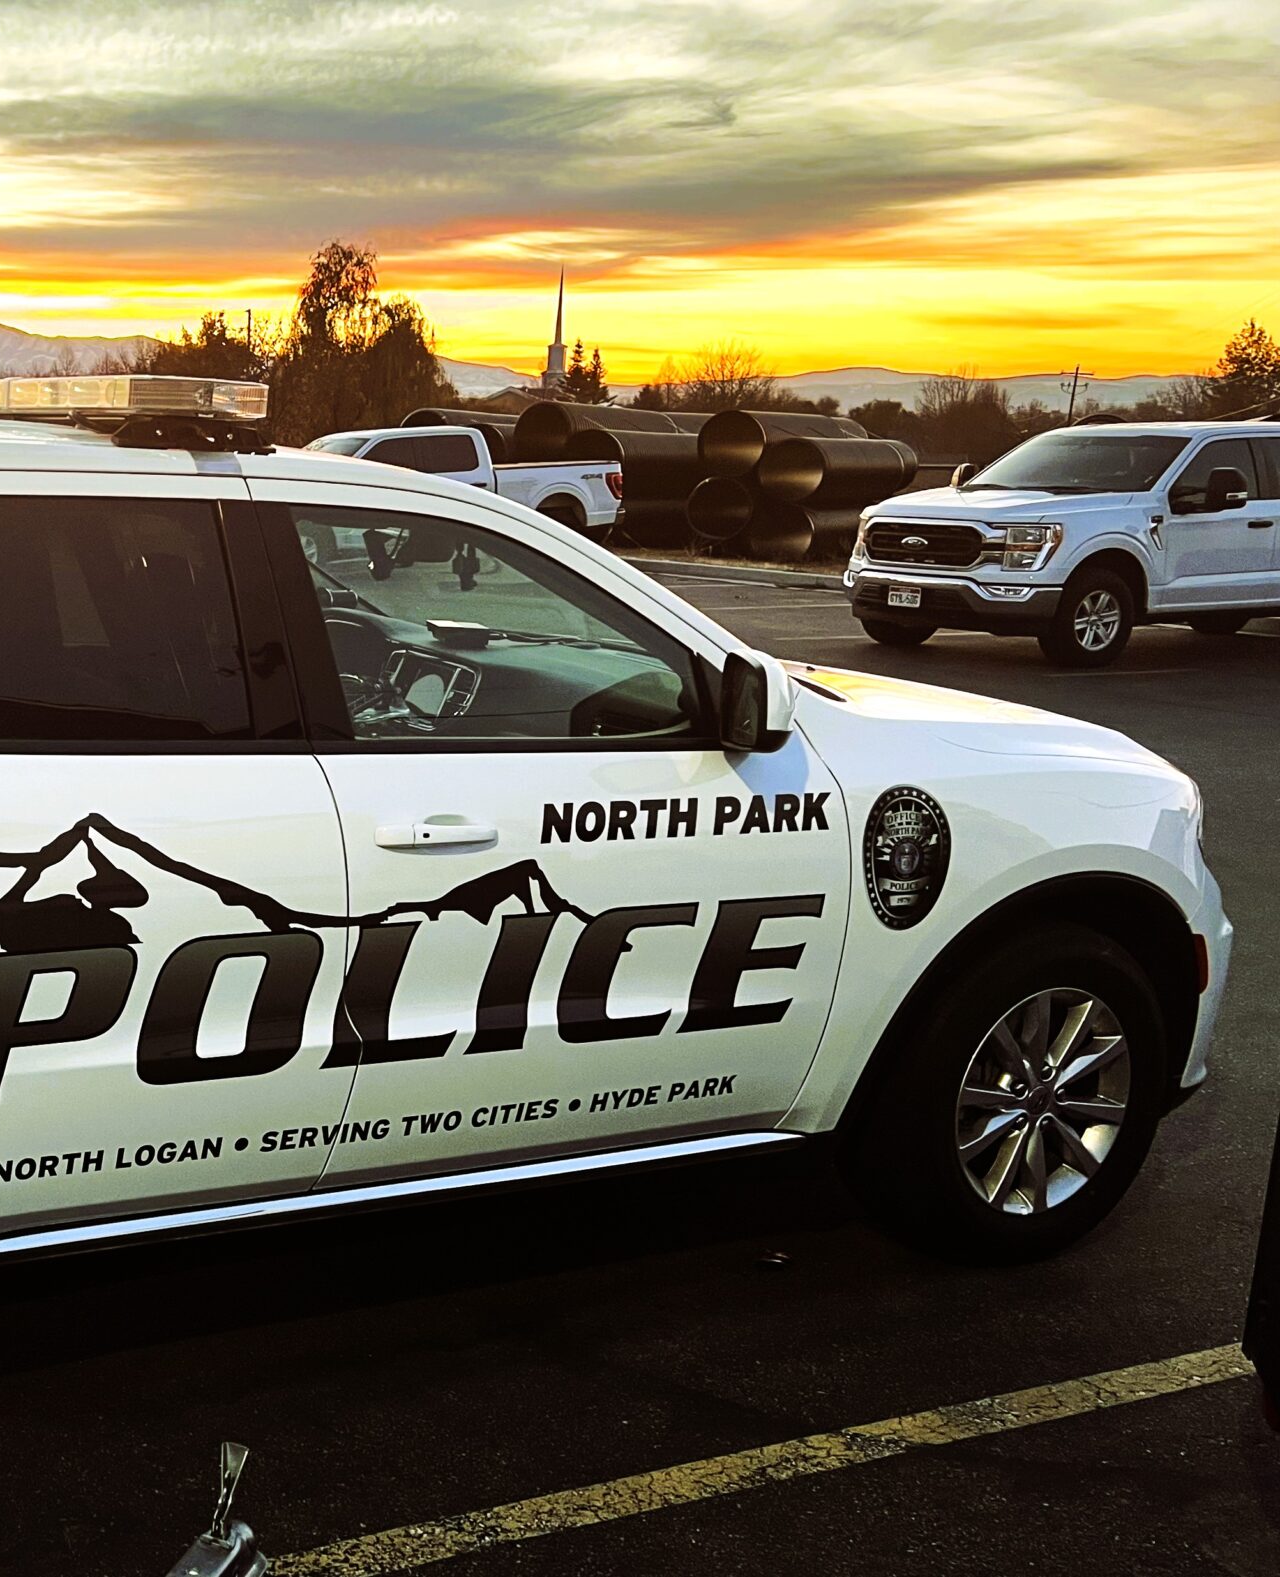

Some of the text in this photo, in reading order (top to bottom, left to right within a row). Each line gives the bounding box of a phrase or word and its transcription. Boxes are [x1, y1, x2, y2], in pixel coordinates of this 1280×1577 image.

[540, 792, 831, 845] NORTH PARK
[116, 1137, 223, 1169] LOGAN
[260, 1121, 391, 1153] SERVING
[402, 1111, 462, 1137] TWO
[472, 1099, 560, 1128] CITIES
[589, 1086, 662, 1113] HYDE
[667, 1075, 738, 1103] PARK
